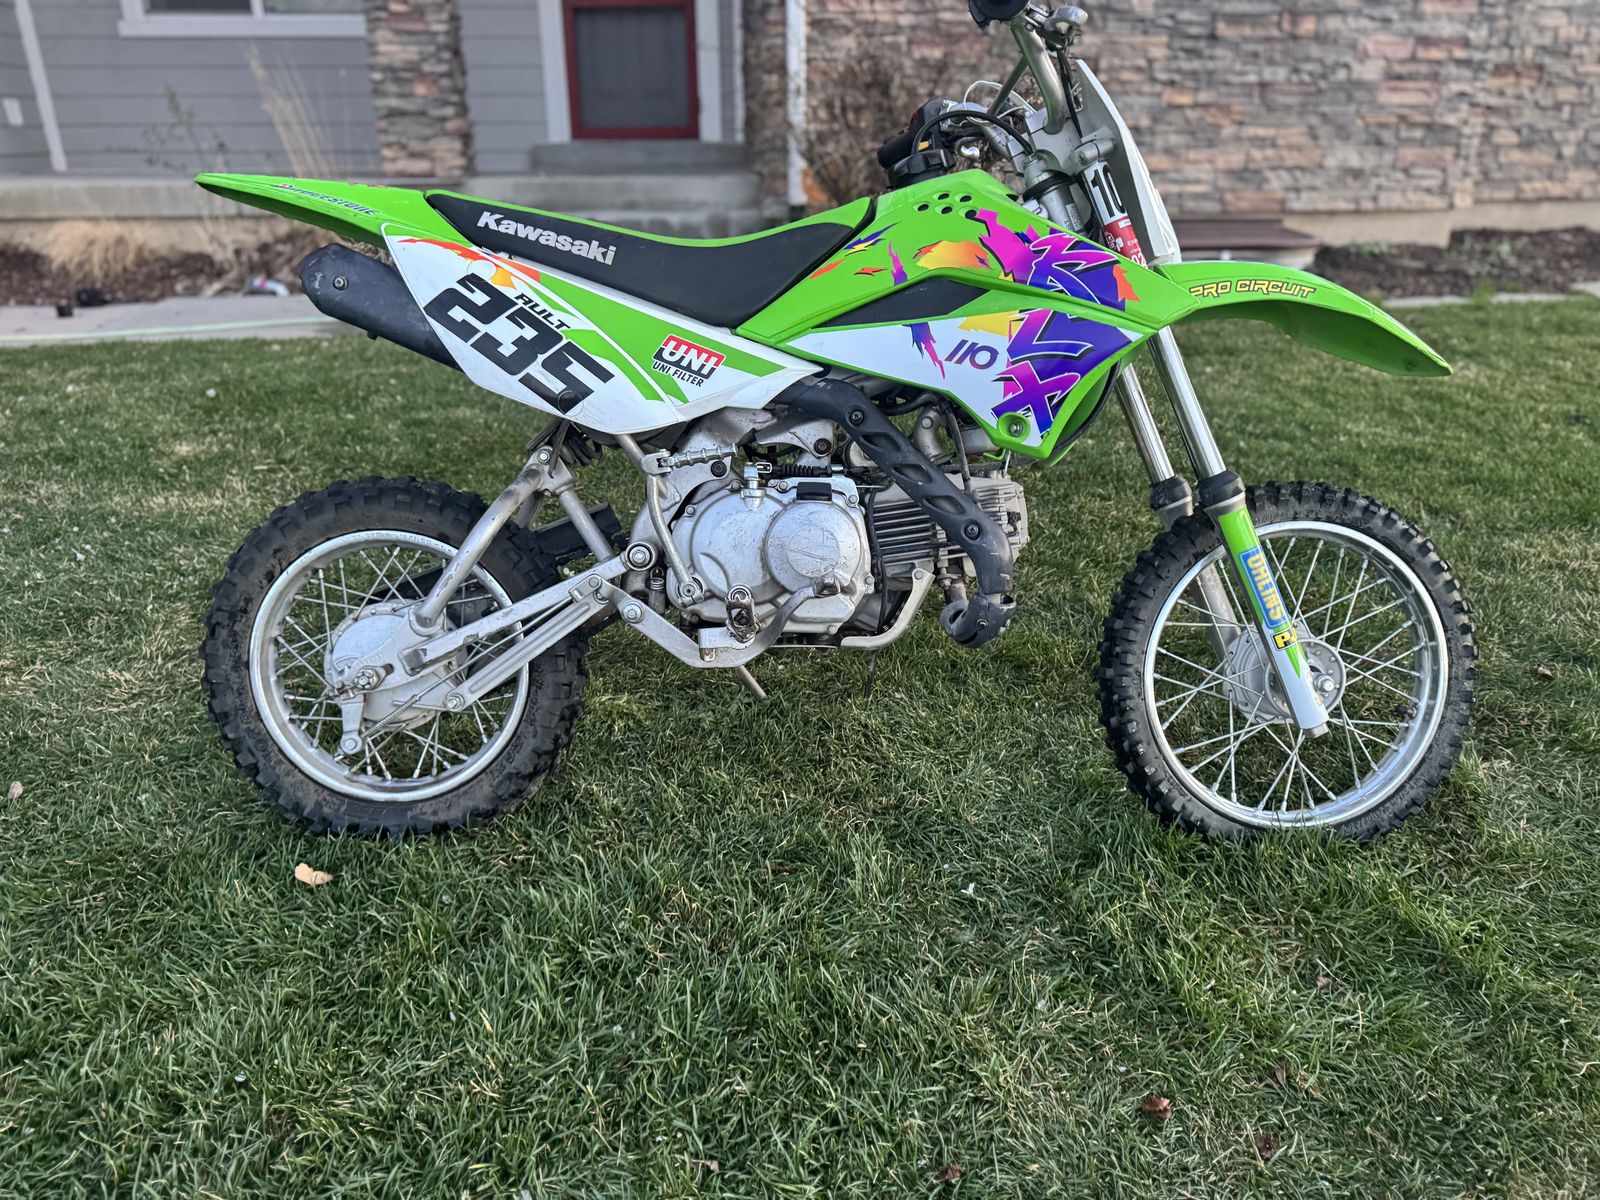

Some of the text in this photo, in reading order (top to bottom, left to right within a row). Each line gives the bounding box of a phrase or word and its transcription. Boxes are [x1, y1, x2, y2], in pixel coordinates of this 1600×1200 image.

[477, 211, 616, 265] Kawasaki
[1189, 279, 1316, 298] PRO CIRCUIT
[423, 273, 615, 415] 235
[662, 340, 719, 375] UNI
[944, 339, 999, 370] 110
[652, 361, 704, 387] UNI FILTER
